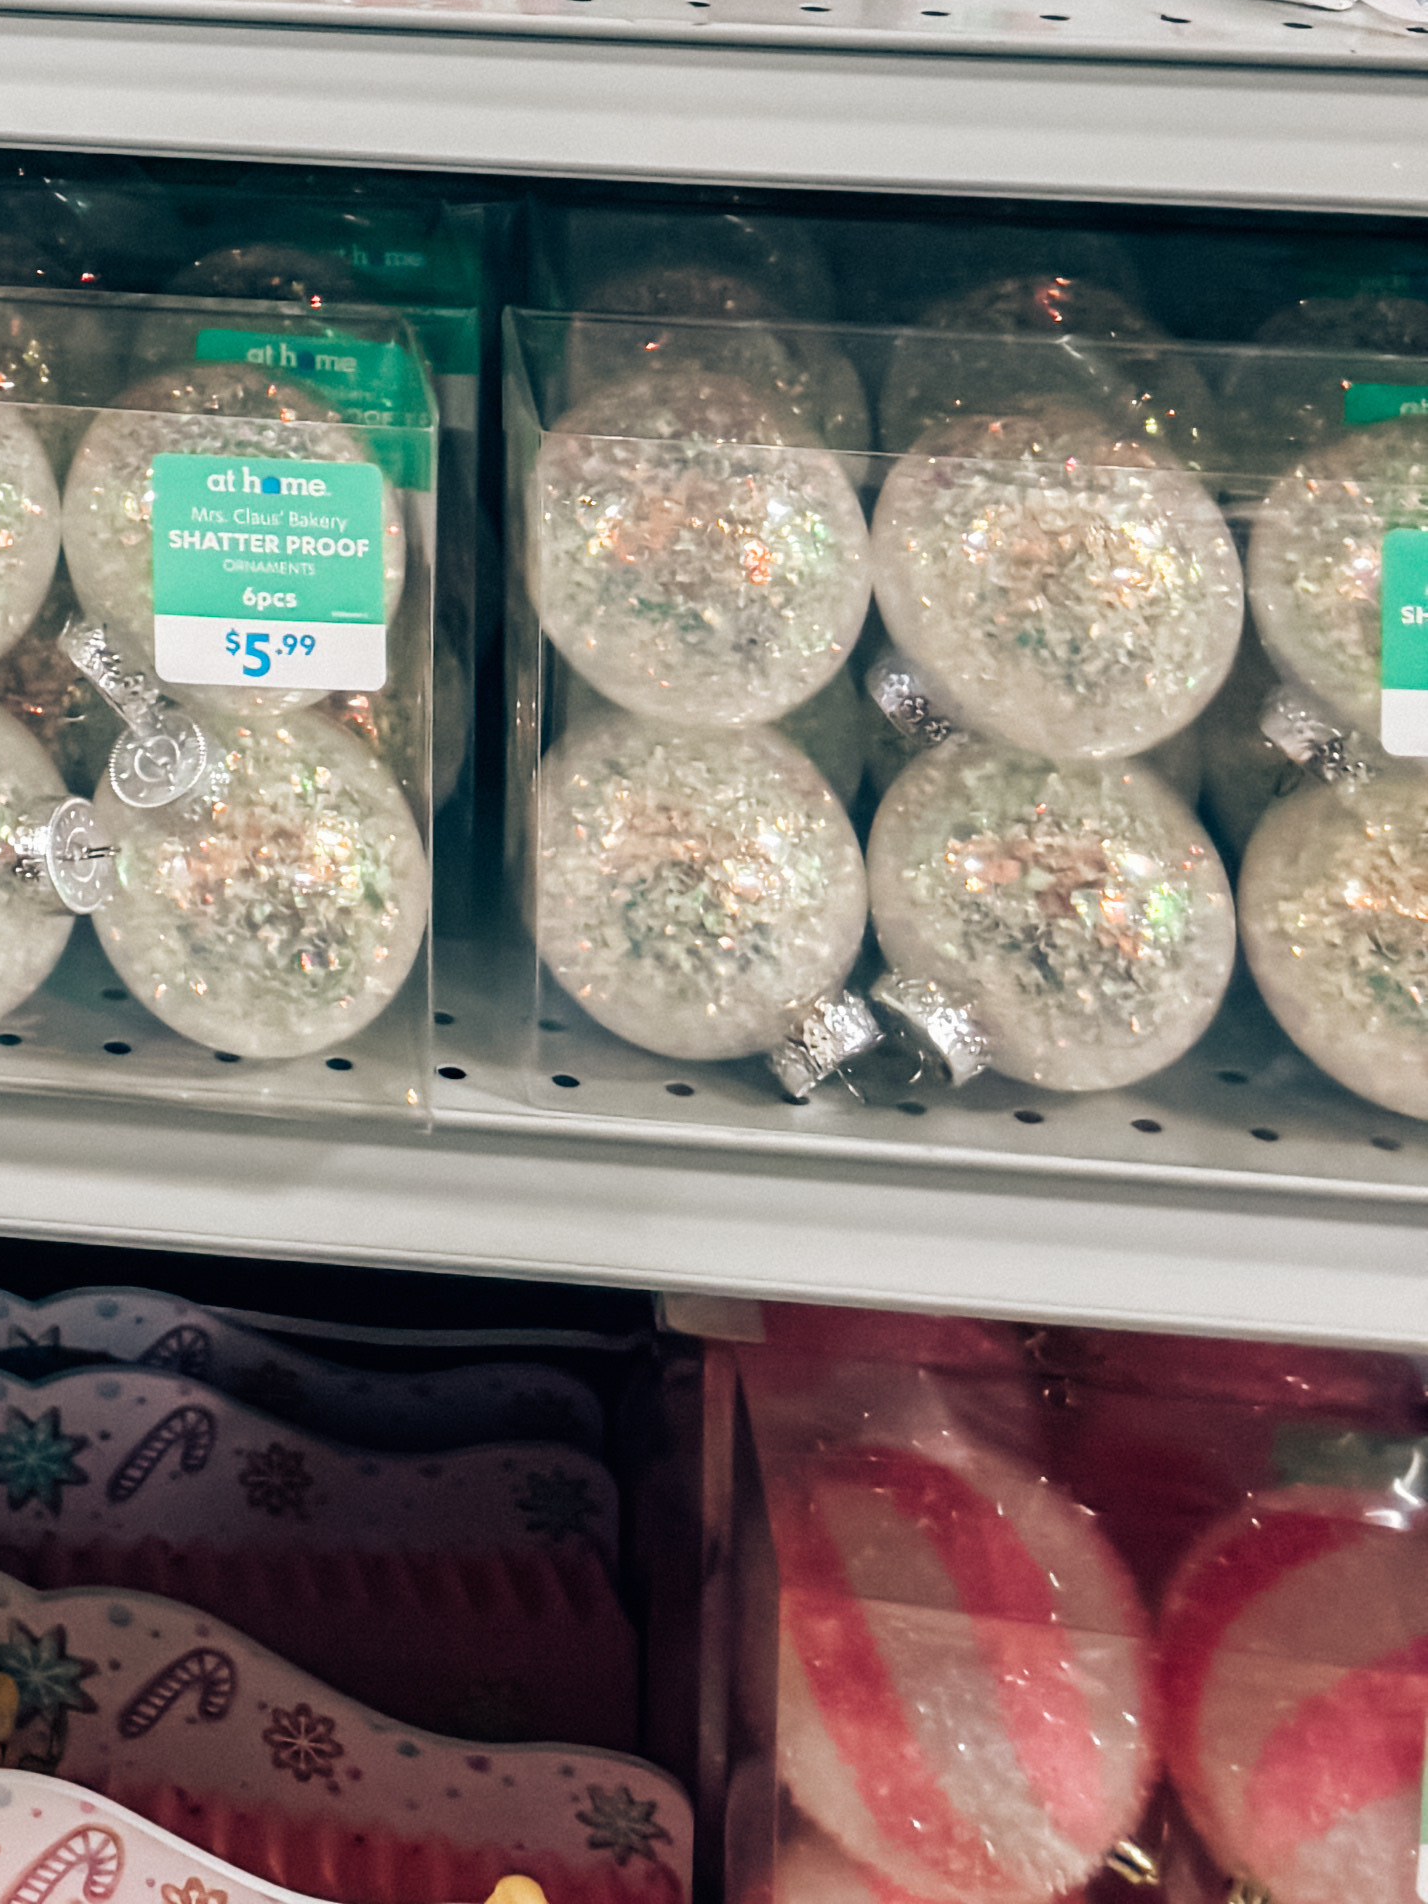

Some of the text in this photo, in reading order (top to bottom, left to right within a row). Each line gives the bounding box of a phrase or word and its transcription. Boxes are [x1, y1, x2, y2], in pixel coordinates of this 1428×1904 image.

[206, 469, 236, 493] at
[191, 506, 348, 533] Mrs. Claus' Bakery
[168, 529, 370, 558] SHATTER PROOF
[222, 558, 316, 577] ORNAMENTS
[242, 586, 298, 612] 6pcs
[225, 627, 316, 678] $5.99
